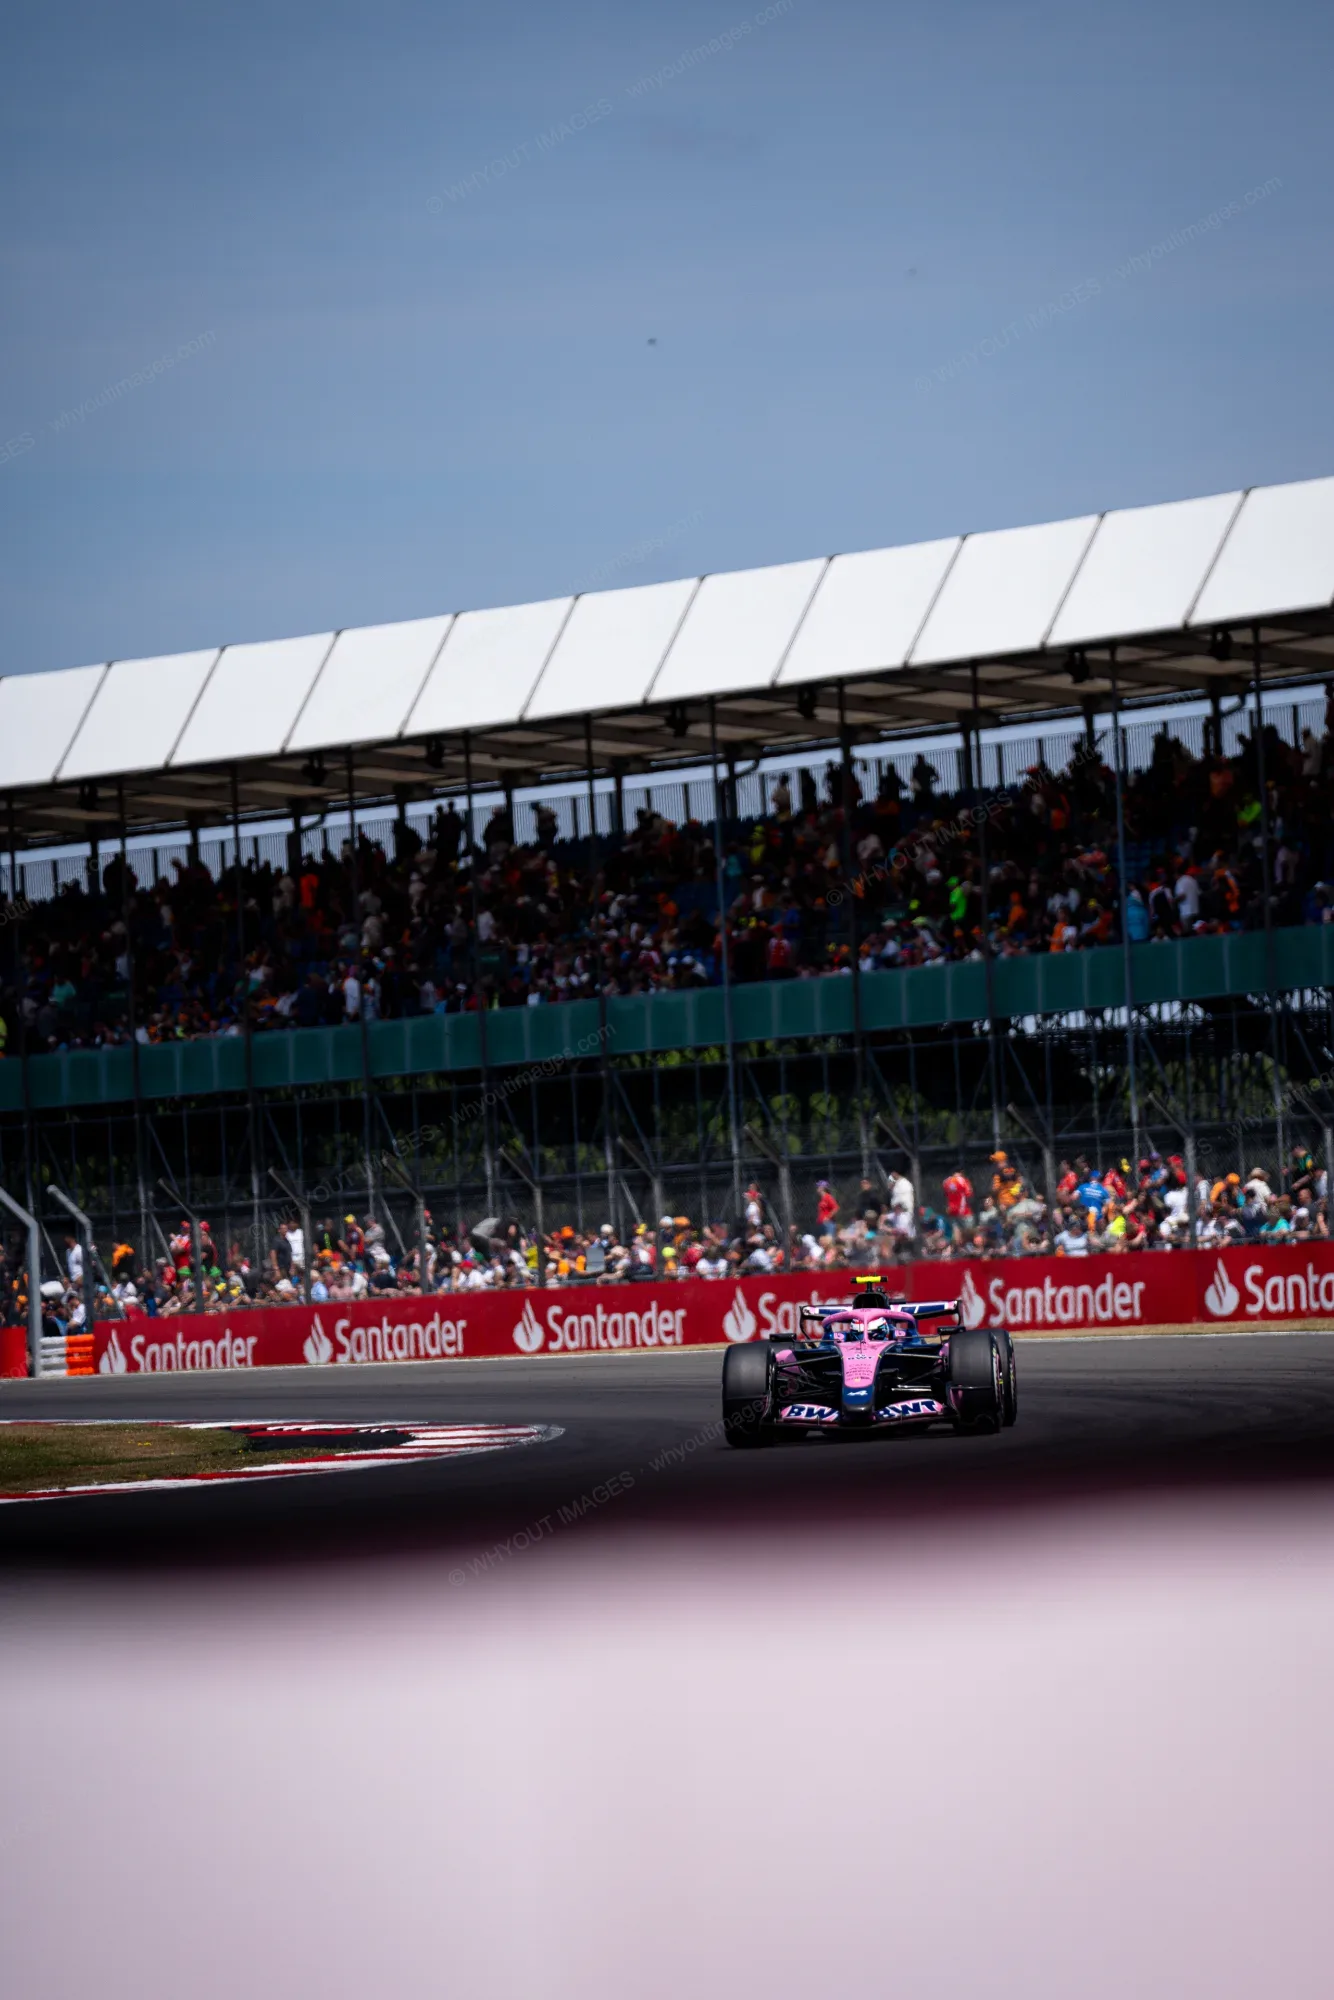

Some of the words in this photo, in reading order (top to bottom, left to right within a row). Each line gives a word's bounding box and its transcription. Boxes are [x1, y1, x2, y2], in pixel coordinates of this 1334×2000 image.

[988, 1272, 1145, 1326] Santander
[130, 1328, 258, 1373] Santander
[334, 1312, 467, 1363] Santander
[546, 1301, 687, 1351] Santander
